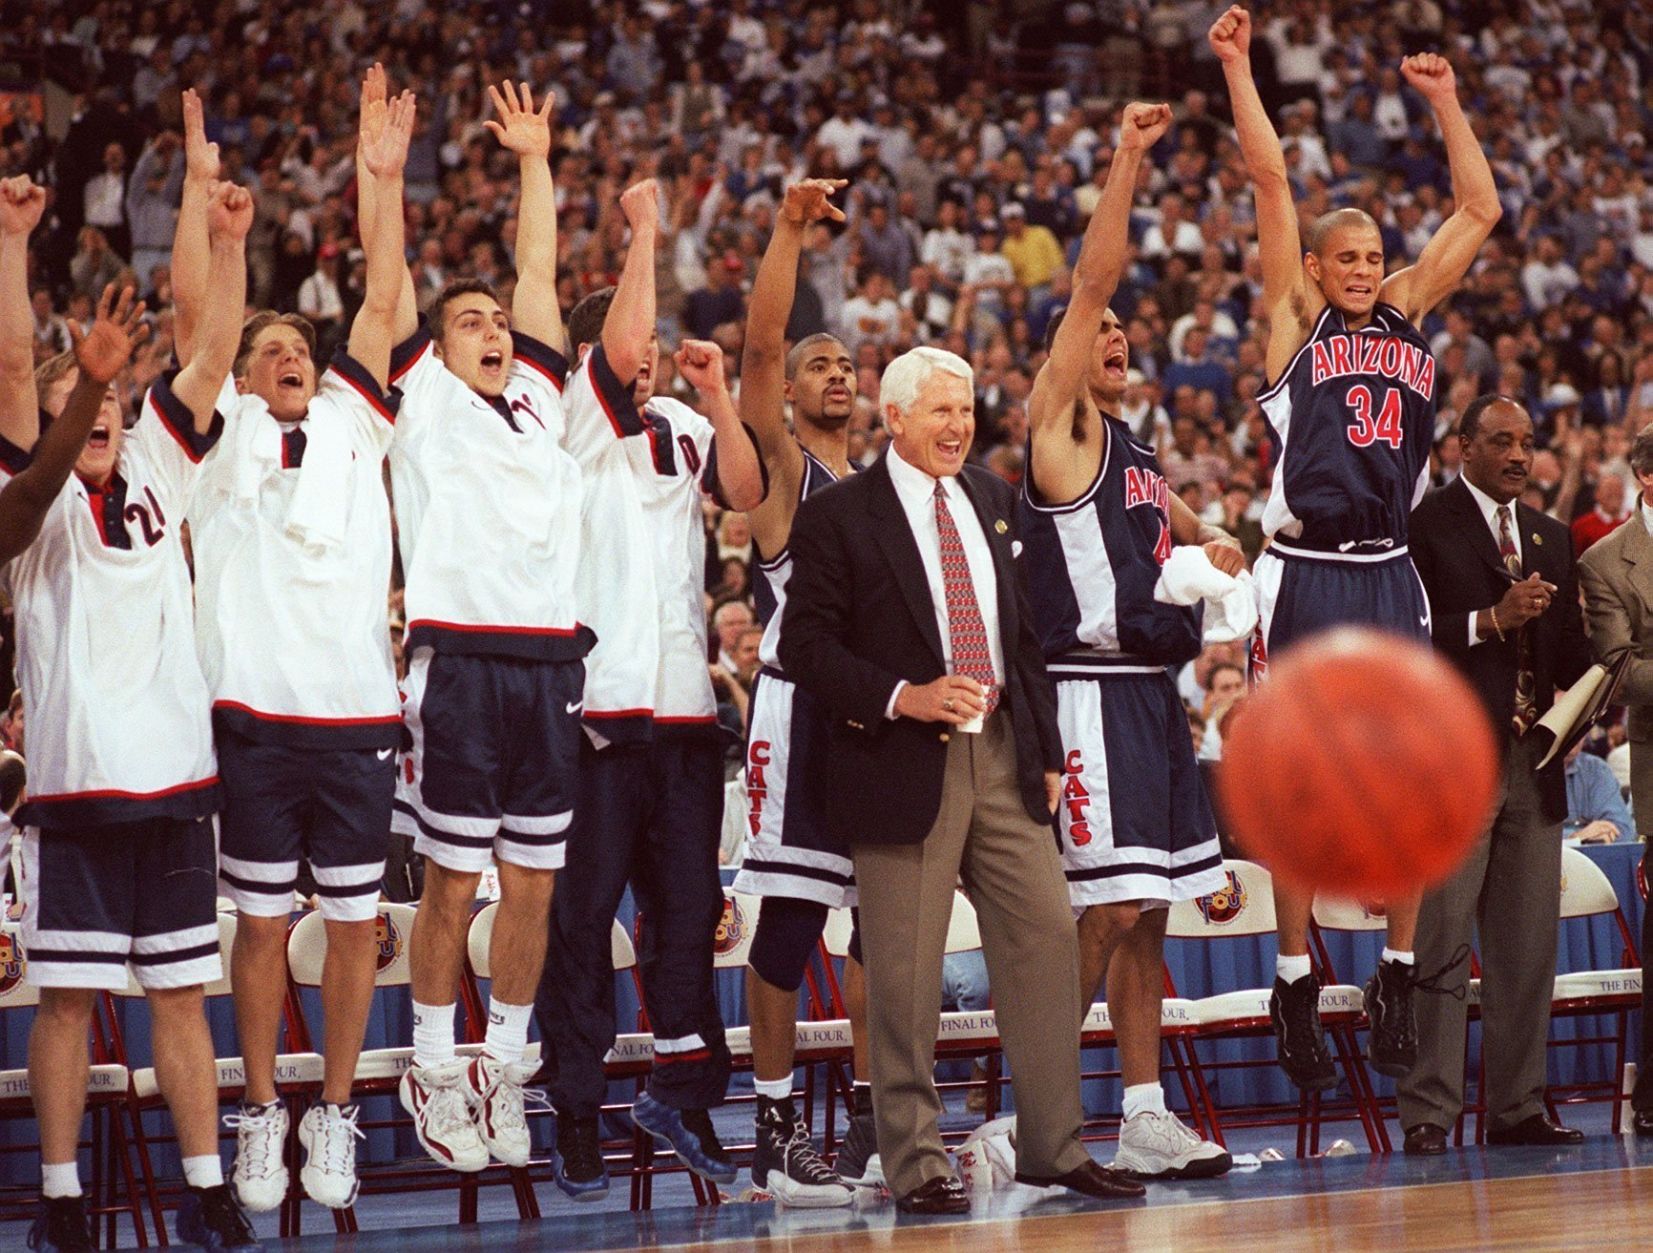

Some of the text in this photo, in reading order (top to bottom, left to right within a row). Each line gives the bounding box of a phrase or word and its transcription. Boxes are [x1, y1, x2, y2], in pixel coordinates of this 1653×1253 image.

[1311, 334, 1435, 401] ARIZONA
[1346, 384, 1403, 449] 34
[124, 485, 167, 548] 21
[1064, 750, 1092, 847] CATS
[1600, 978, 1642, 992] THE FIN
[941, 1017, 996, 1032] FINAL FO
[611, 1043, 655, 1057] NAL FO
[221, 1067, 243, 1080] FIN
